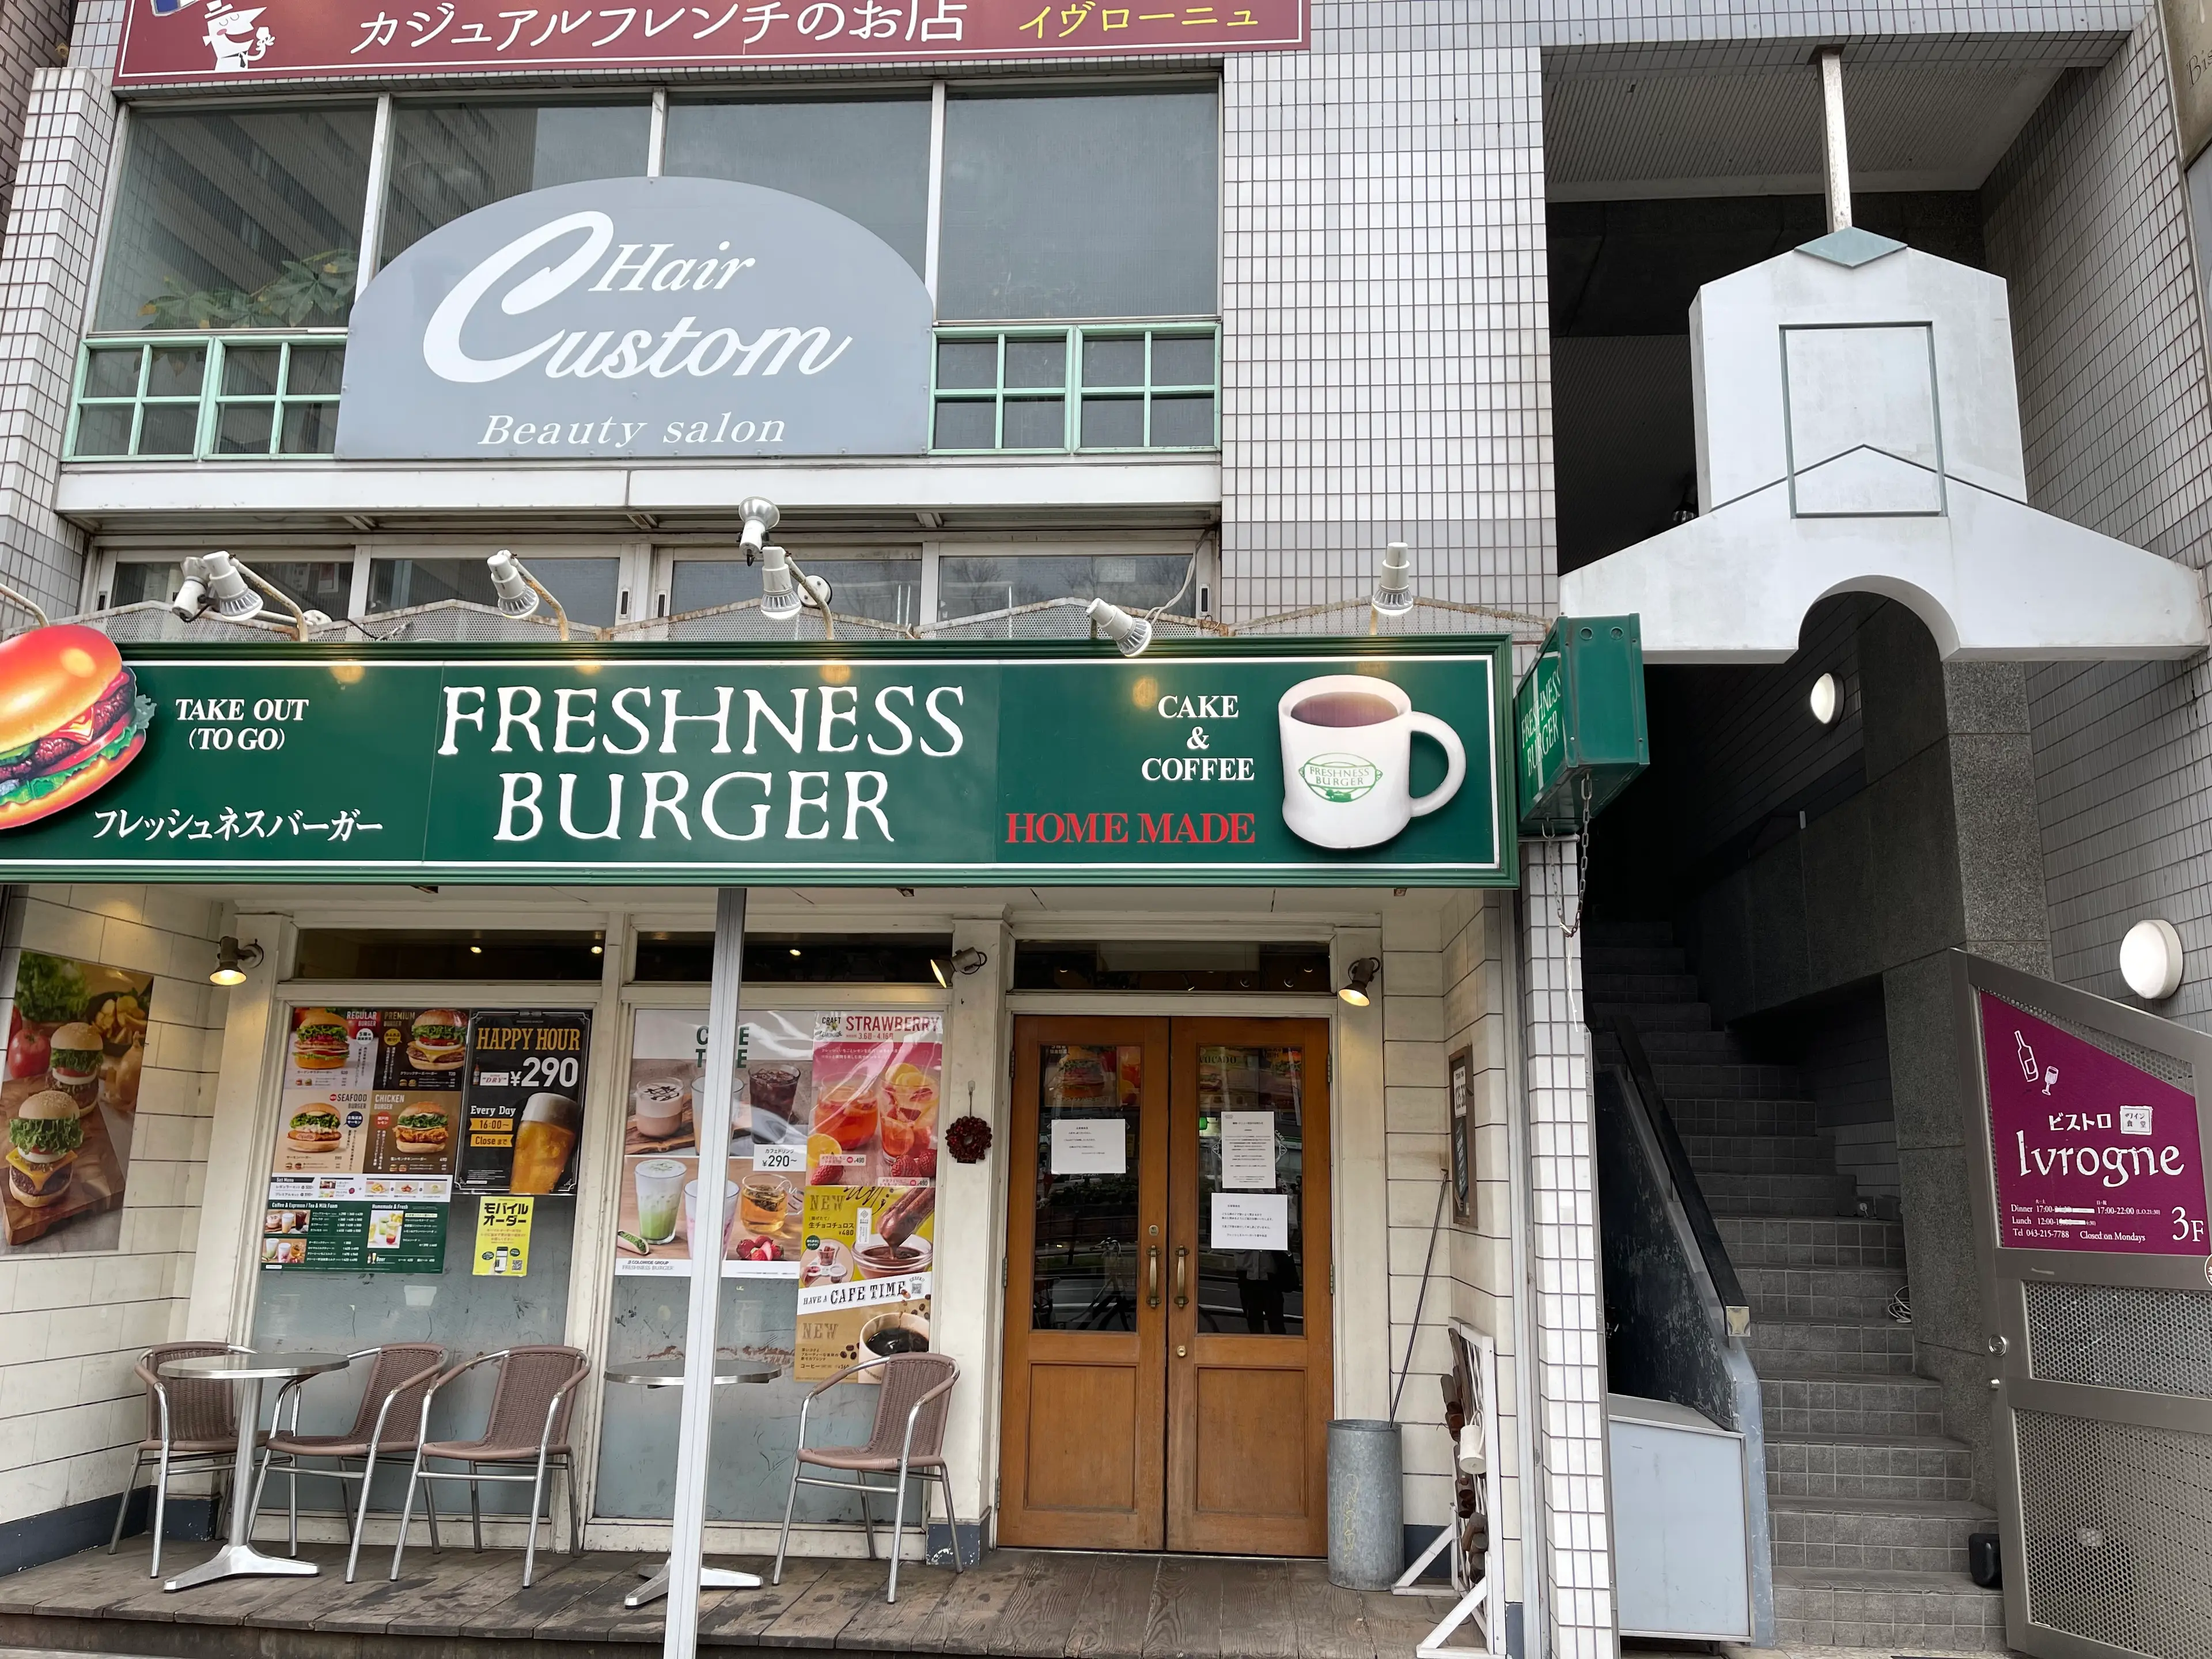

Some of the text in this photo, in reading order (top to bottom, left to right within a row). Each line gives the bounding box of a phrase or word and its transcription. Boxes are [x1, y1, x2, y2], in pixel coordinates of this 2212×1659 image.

[350, 0, 1258, 54] カジュアルフレンチのお店 イヴローニュ
[588, 240, 755, 291] Hair
[422, 210, 853, 383] Custom
[478, 411, 786, 448] Beauty salon
[175, 698, 309, 722] TAKE OUT
[1158, 695, 1238, 718] CAKE
[437, 685, 964, 756] FRESHNESS
[189, 728, 285, 750] (TO GO)
[1186, 726, 1210, 749] &
[1527, 710, 1559, 777] BURGER
[1141, 757, 1255, 781] COFFEE
[1309, 766, 1369, 778] FRESHNESS
[1316, 776, 1364, 786] BURGER
[493, 770, 895, 842] BURGER
[93, 806, 384, 842] フレッシュネスバーガー
[1005, 813, 1256, 844] HOME MADE
[346, 1011, 415, 1020] REGULAR PREMIUM
[822, 1017, 841, 1026] CRAFT
[845, 1016, 940, 1032] STRAWBERRY
[476, 1028, 580, 1051] HAPPY HOUR
[510, 1056, 578, 1088] ¥290
[337, 1094, 367, 1102] SEAFOOD
[375, 1094, 405, 1103] CHICKEN
[470, 1105, 516, 1117] Every Day
[2048, 1112, 2112, 1131] ビストロ
[475, 1136, 496, 1145] Close
[1274, 1130, 1285, 1141] CAKE
[2016, 1130, 2184, 1188] Ivrogne
[484, 1203, 529, 1214] モバイル
[809, 1194, 846, 1211] NEW
[2011, 1204, 2033, 1213] Dinner
[2097, 1207, 2134, 1215] 17:00-22:00
[483, 1215, 527, 1226] オーダー
[2012, 1216, 2032, 1225] Lunch
[2171, 1206, 2205, 1242] 3F
[2013, 1228, 2023, 1237] Tel
[2026, 1229, 2069, 1238] 043-215-7788
[2080, 1230, 2103, 1240] Closed
[2115, 1232, 2146, 1243] Mondays
[803, 1296, 822, 1305] HAVE
[830, 1286, 866, 1305] CAFE
[870, 1280, 906, 1300] TIME
[802, 1323, 839, 1340] NEW
